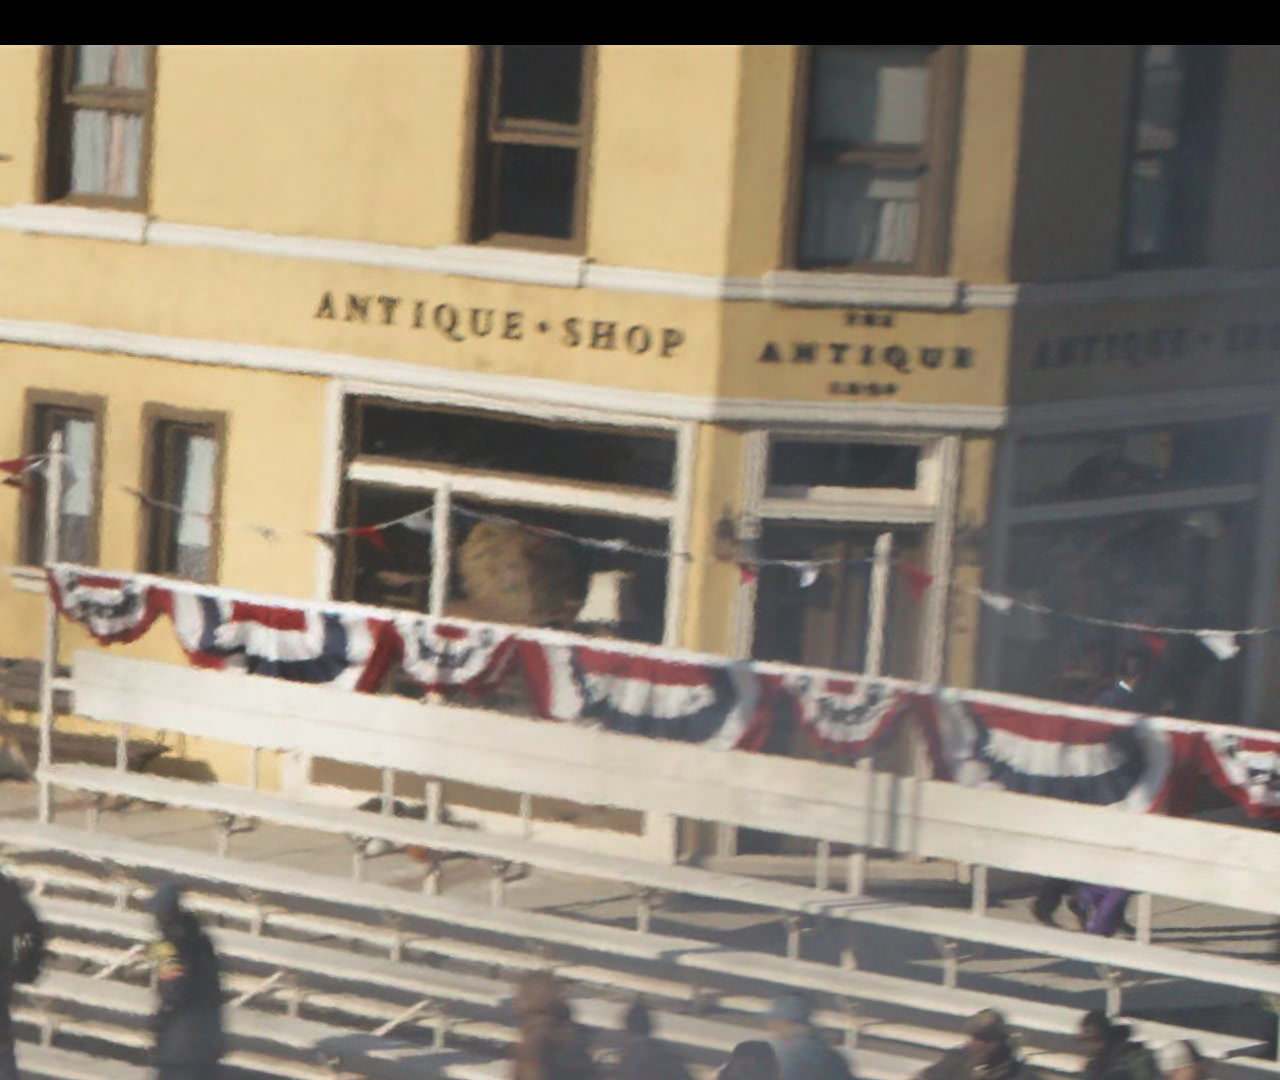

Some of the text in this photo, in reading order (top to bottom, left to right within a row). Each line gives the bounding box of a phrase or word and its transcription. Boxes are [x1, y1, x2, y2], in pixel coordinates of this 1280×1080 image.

[314, 290, 684, 358] ANTIQUE SHOP
[758, 341, 975, 374] ANTIQUE
